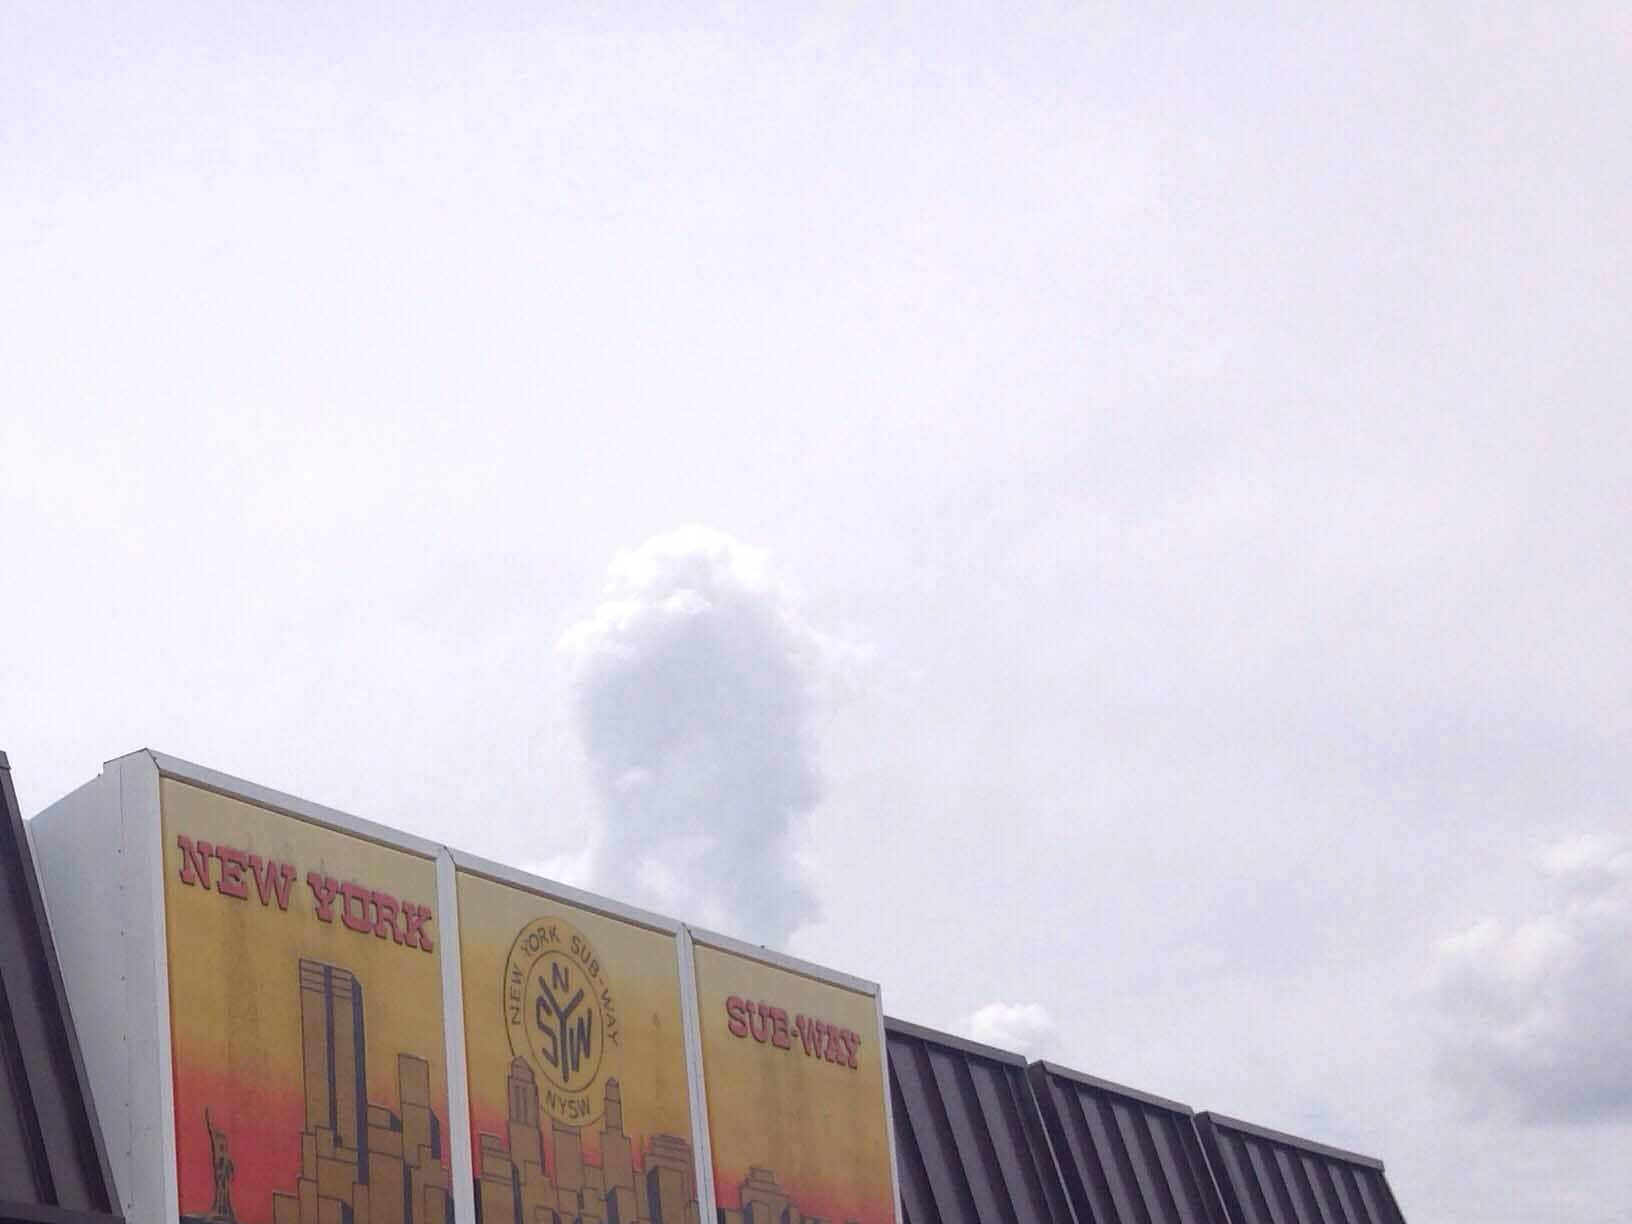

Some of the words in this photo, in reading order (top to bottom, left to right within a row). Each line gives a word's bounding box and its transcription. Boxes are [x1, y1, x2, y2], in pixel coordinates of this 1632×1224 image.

[177, 834, 297, 912] NEW
[306, 871, 433, 953] YORK
[507, 963, 524, 1025] NEW
[520, 924, 561, 957] YORK
[570, 934, 619, 1047] SUB-WAY
[725, 995, 862, 1070] SUB-WAY
[546, 1089, 591, 1119] NYSW
